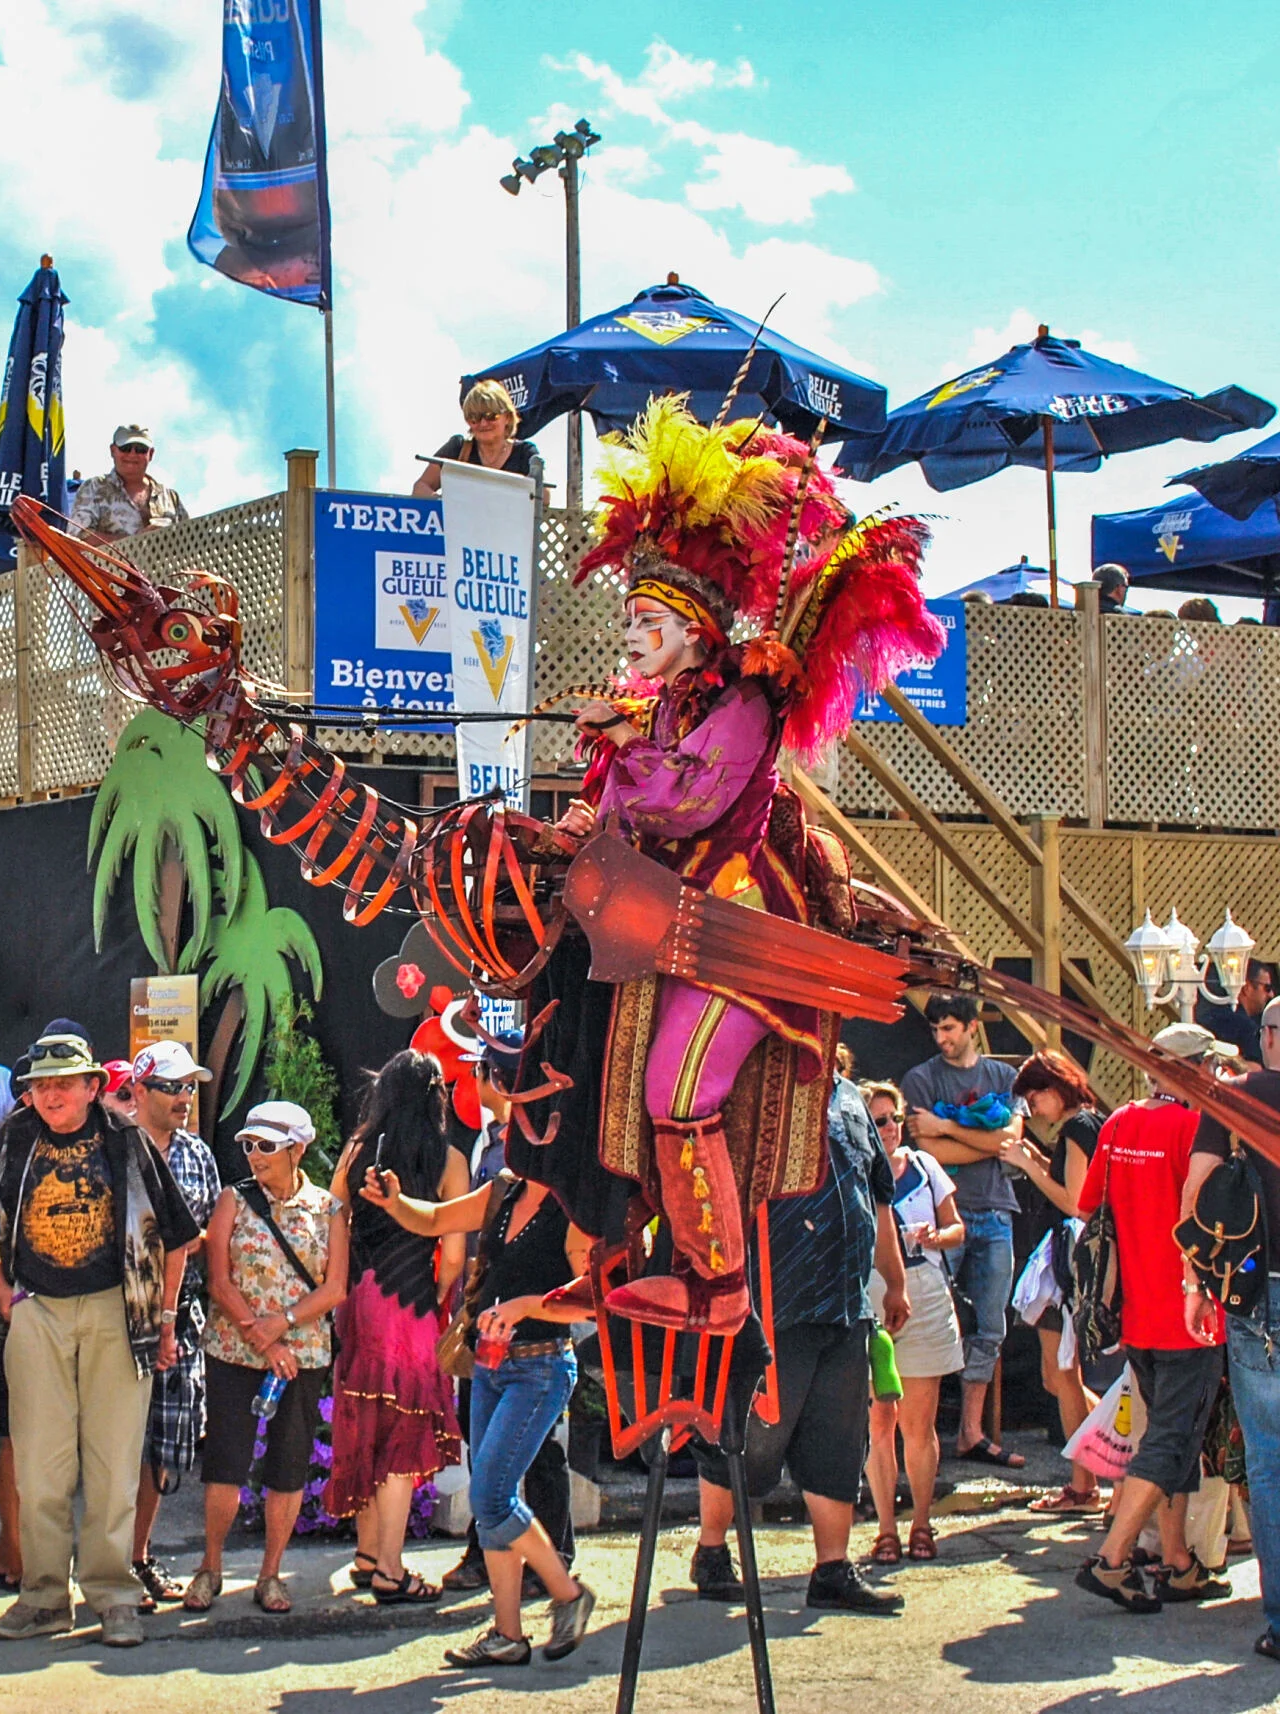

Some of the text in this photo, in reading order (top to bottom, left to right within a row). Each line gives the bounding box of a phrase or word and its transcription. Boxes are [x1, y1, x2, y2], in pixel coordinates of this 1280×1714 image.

[809, 374, 839, 402] BELLE
[392, 559, 448, 581] BELLE
[461, 546, 520, 586] BELLE
[382, 577, 449, 599] GUEUL
[454, 578, 528, 621] GUEULE
[899, 687, 943, 698] OMMERCE
